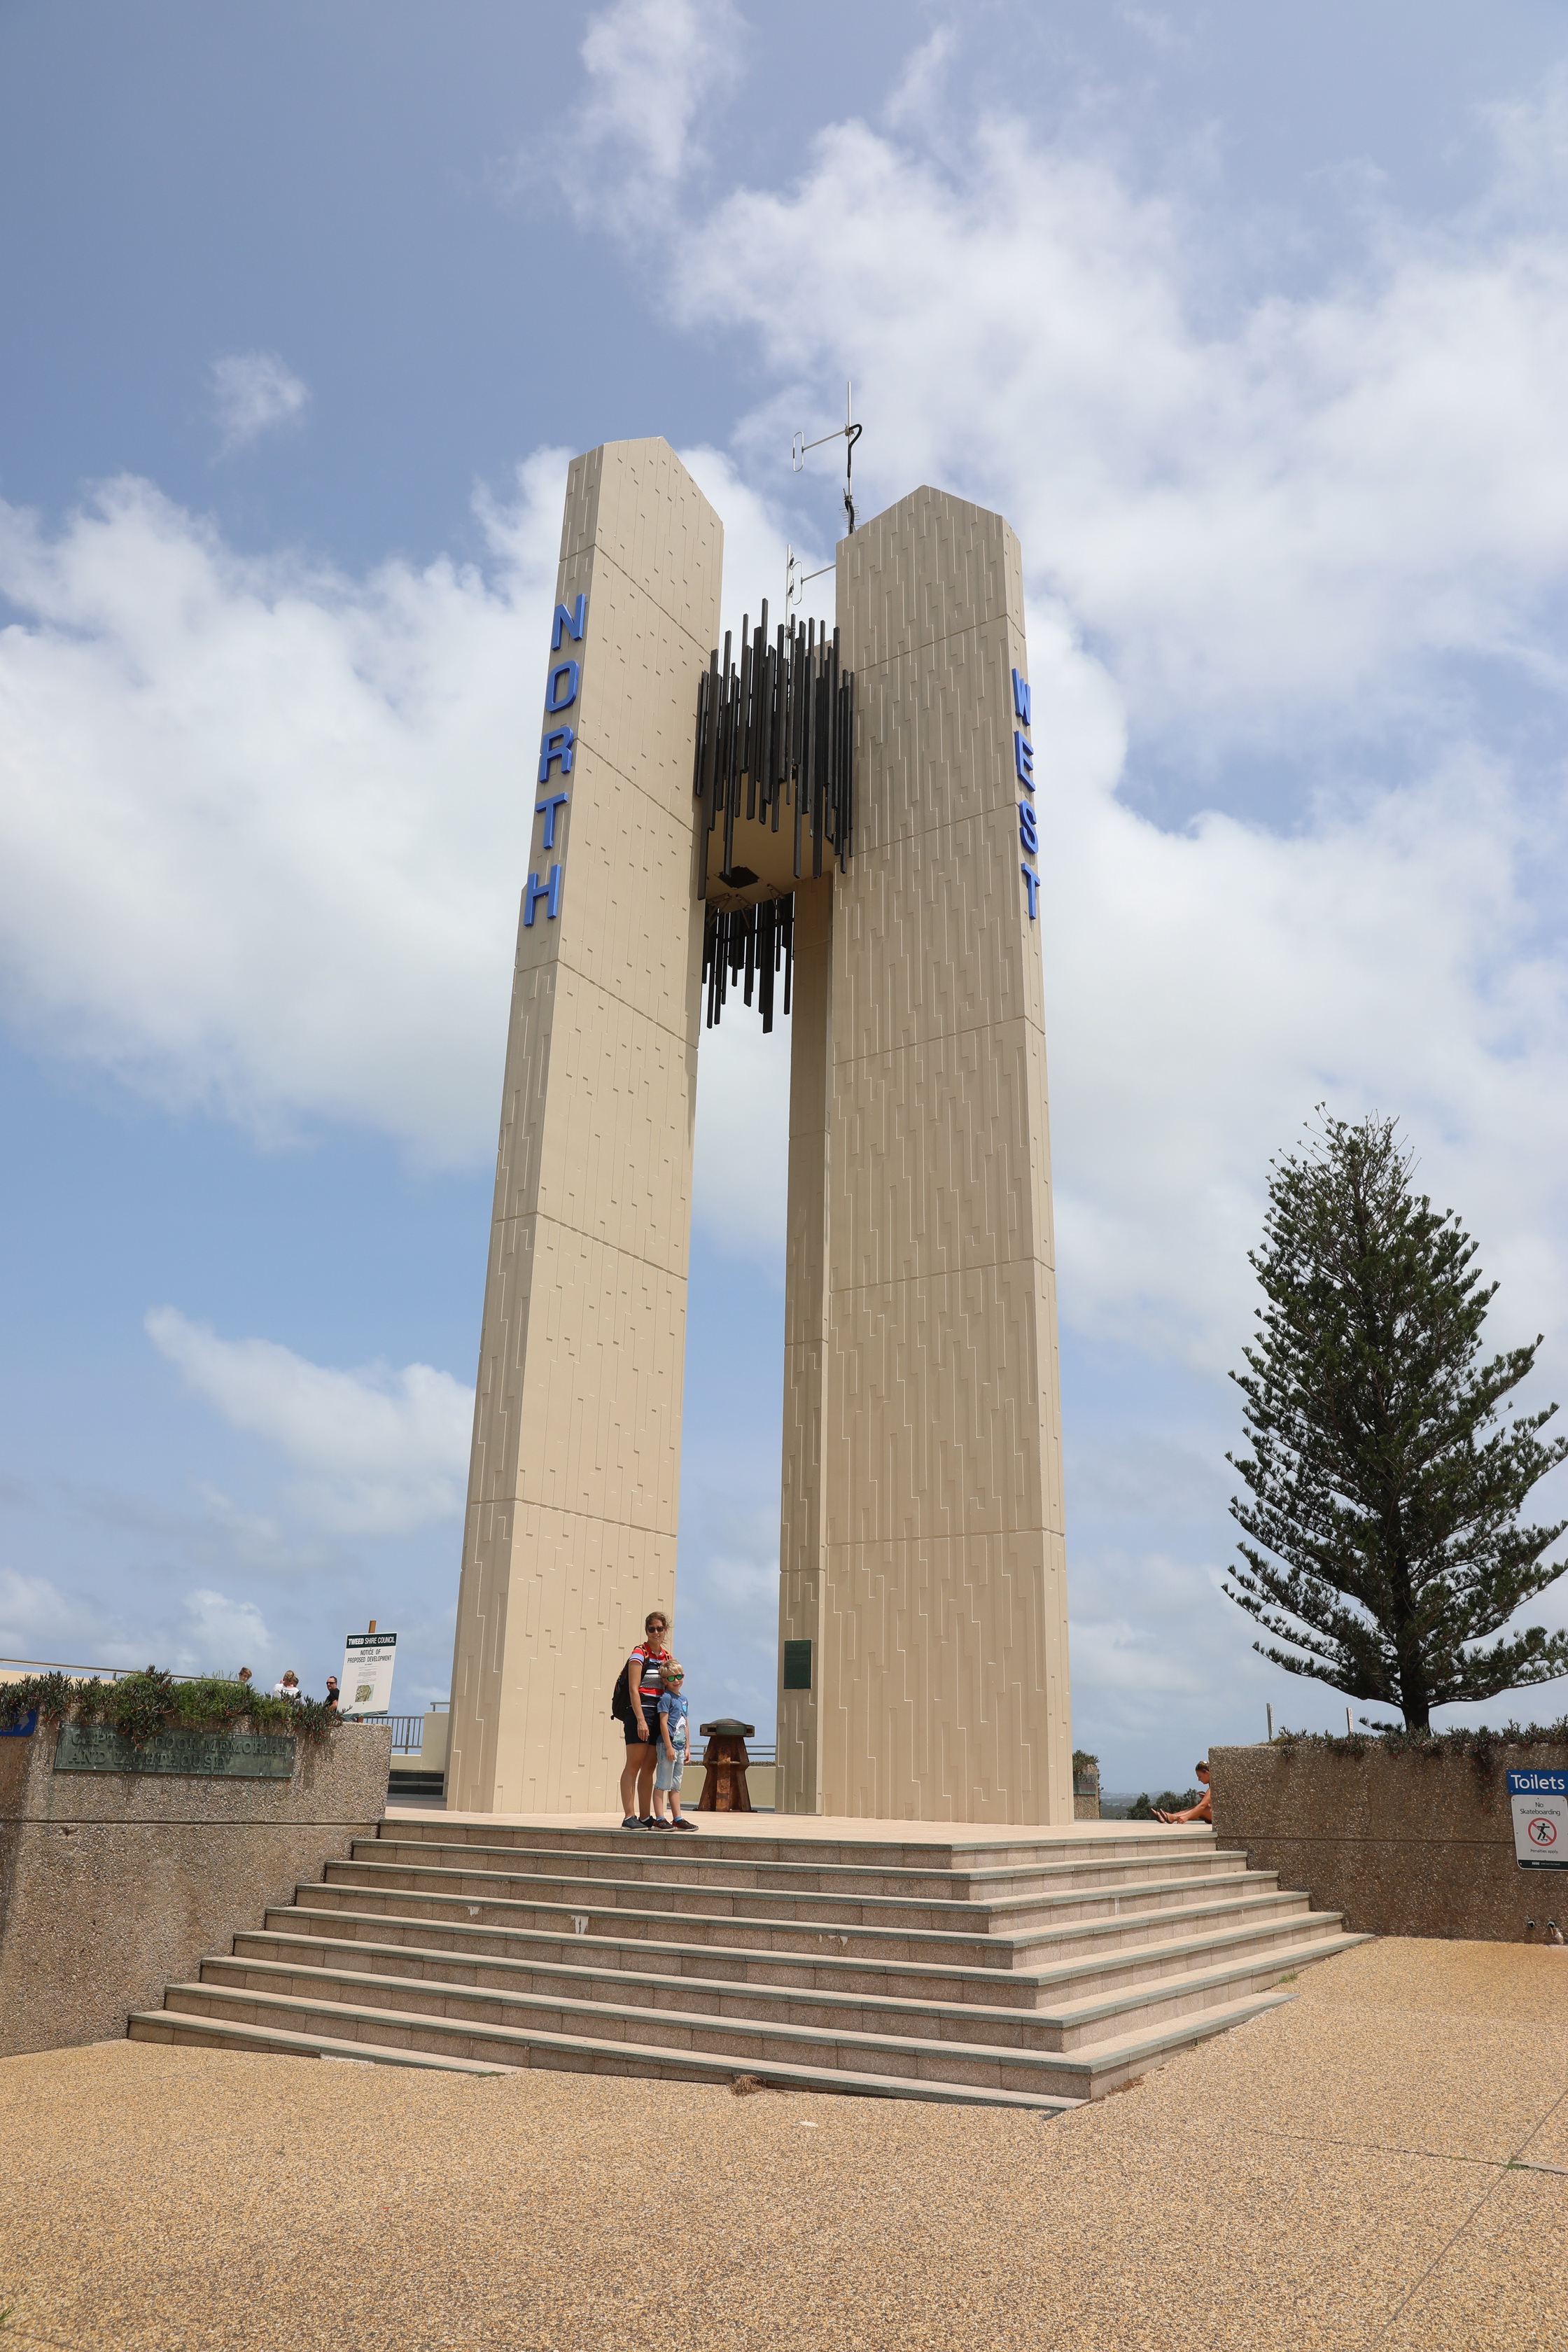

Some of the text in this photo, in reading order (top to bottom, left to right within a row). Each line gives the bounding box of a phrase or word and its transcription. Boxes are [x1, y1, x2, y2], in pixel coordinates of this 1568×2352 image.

[523, 594, 585, 927] NORTH
[1012, 668, 1040, 920] WEST
[72, 1730, 288, 1756] CAPTA COOK MEMORIAL
[69, 1749, 225, 1768] AND LIGHTHOUSE
[1511, 1774, 1565, 1790] Toilets
[1520, 1808, 1561, 1816] Skateboarding
